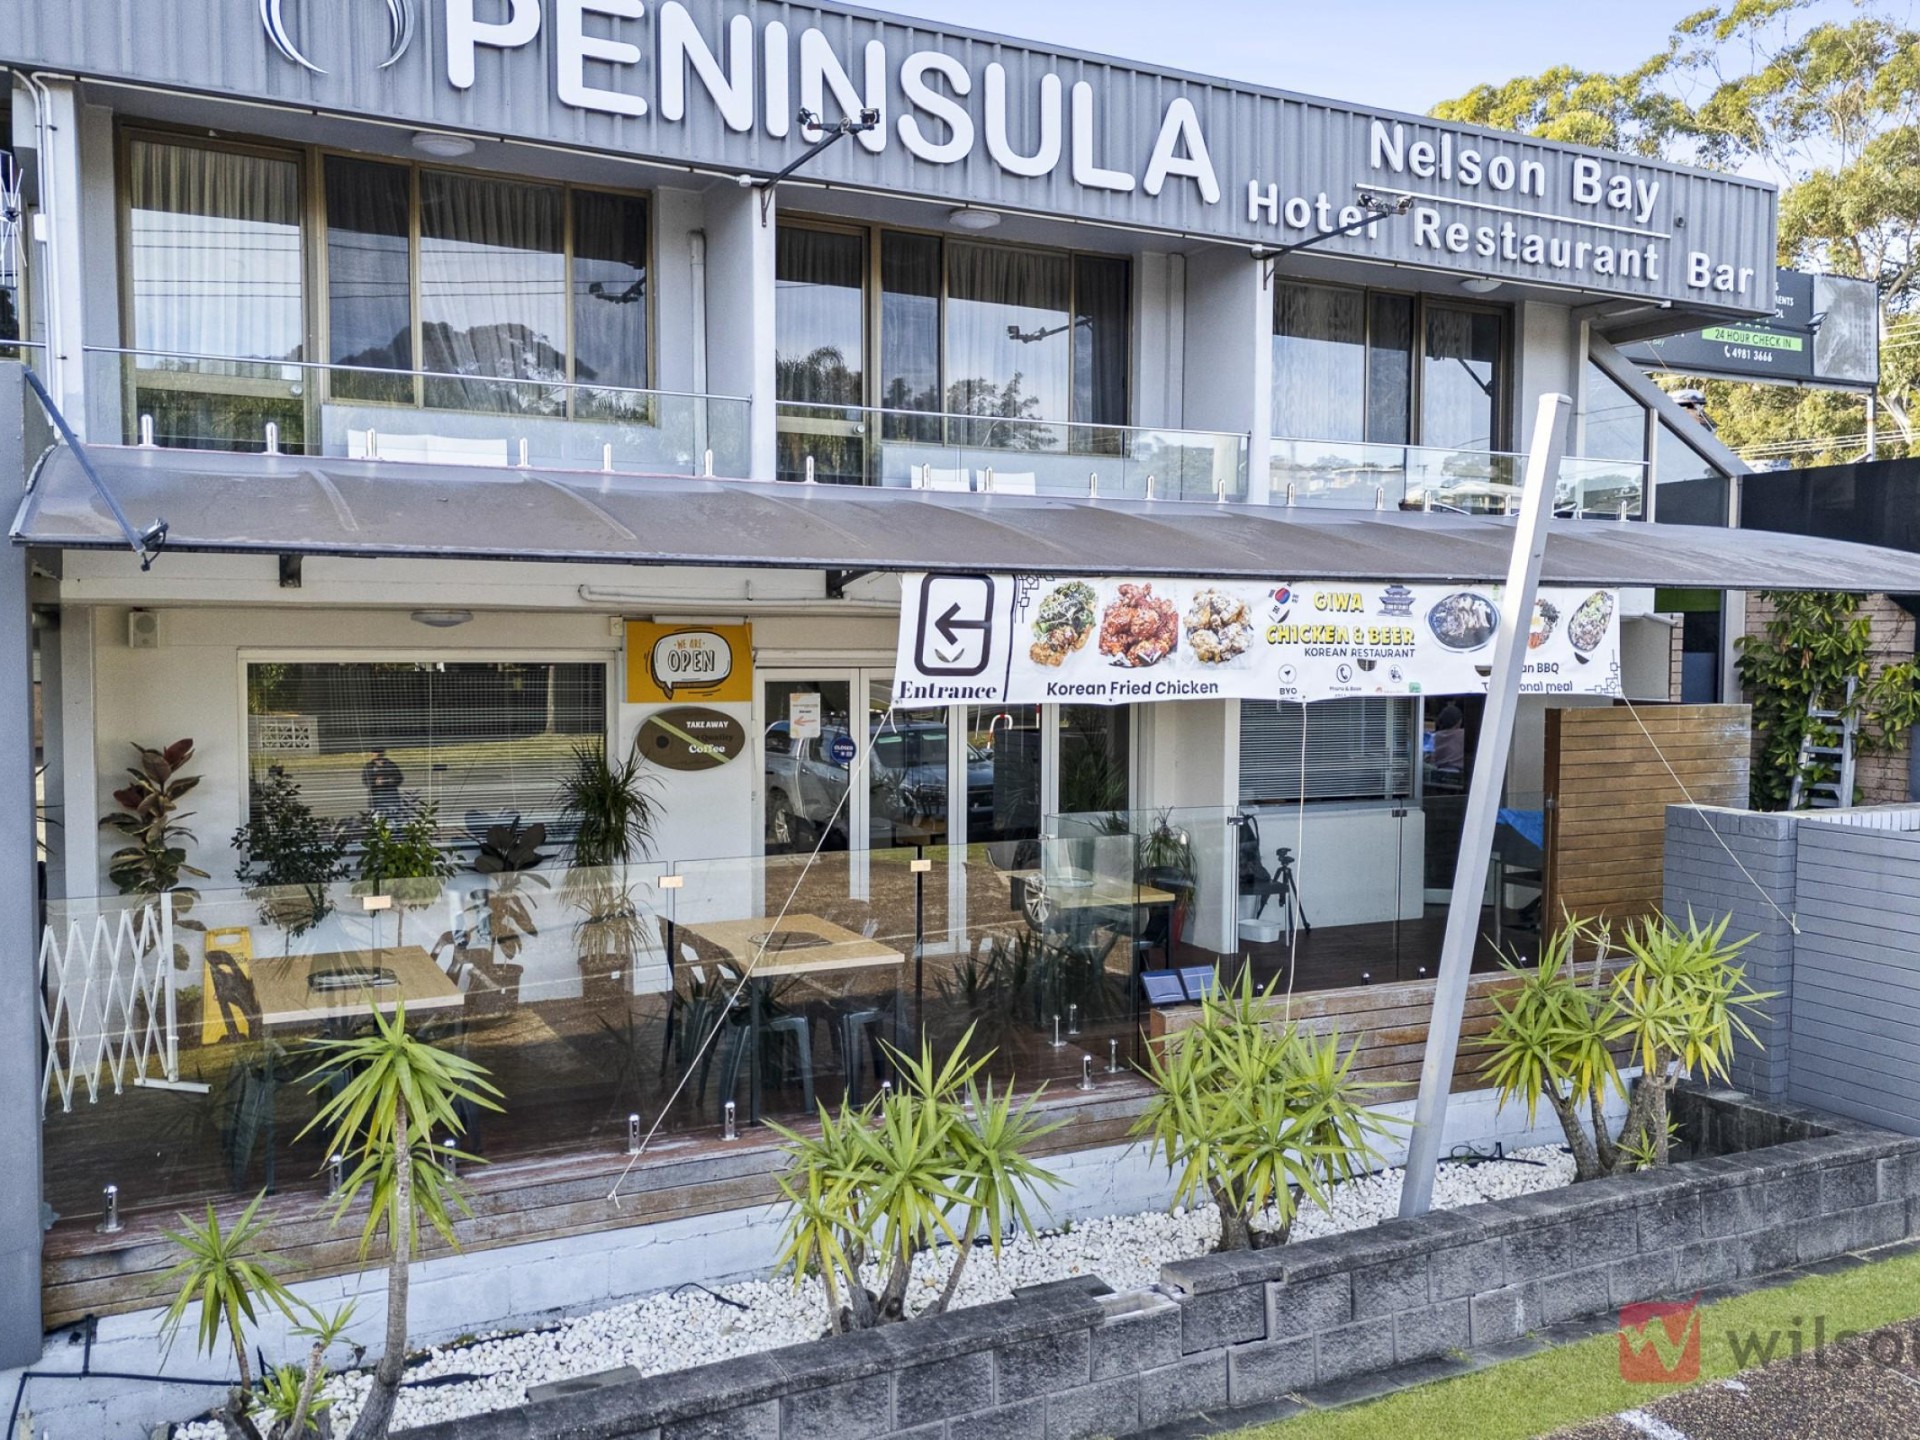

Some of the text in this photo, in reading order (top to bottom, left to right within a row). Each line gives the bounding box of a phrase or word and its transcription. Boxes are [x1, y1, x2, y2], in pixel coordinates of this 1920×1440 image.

[446, 0, 1221, 204] PENINSULA
[1370, 120, 1660, 223] Nelson Bay
[1414, 206, 1660, 281] Restaurant
[1687, 252, 1754, 294] Bar
[1715, 328, 1791, 349] 24 HOUR CHECK IN
[1732, 347, 1751, 360] 4981
[1313, 591, 1365, 613] GIWA
[1266, 623, 1349, 645] CHICKEN
[1368, 626, 1415, 646] BEER
[667, 649, 715, 672] OPEN
[1304, 647, 1415, 658] KOREAN RESTAURANT
[1537, 662, 1559, 675] BBQ
[900, 681, 998, 699] Entrance
[1046, 679, 1219, 696] Korean Fried Chicken
[1279, 687, 1298, 696] BYO
[1545, 680, 1573, 693] meal
[686, 720, 729, 729] TAKE AWAY
[688, 743, 726, 754] Coffee
